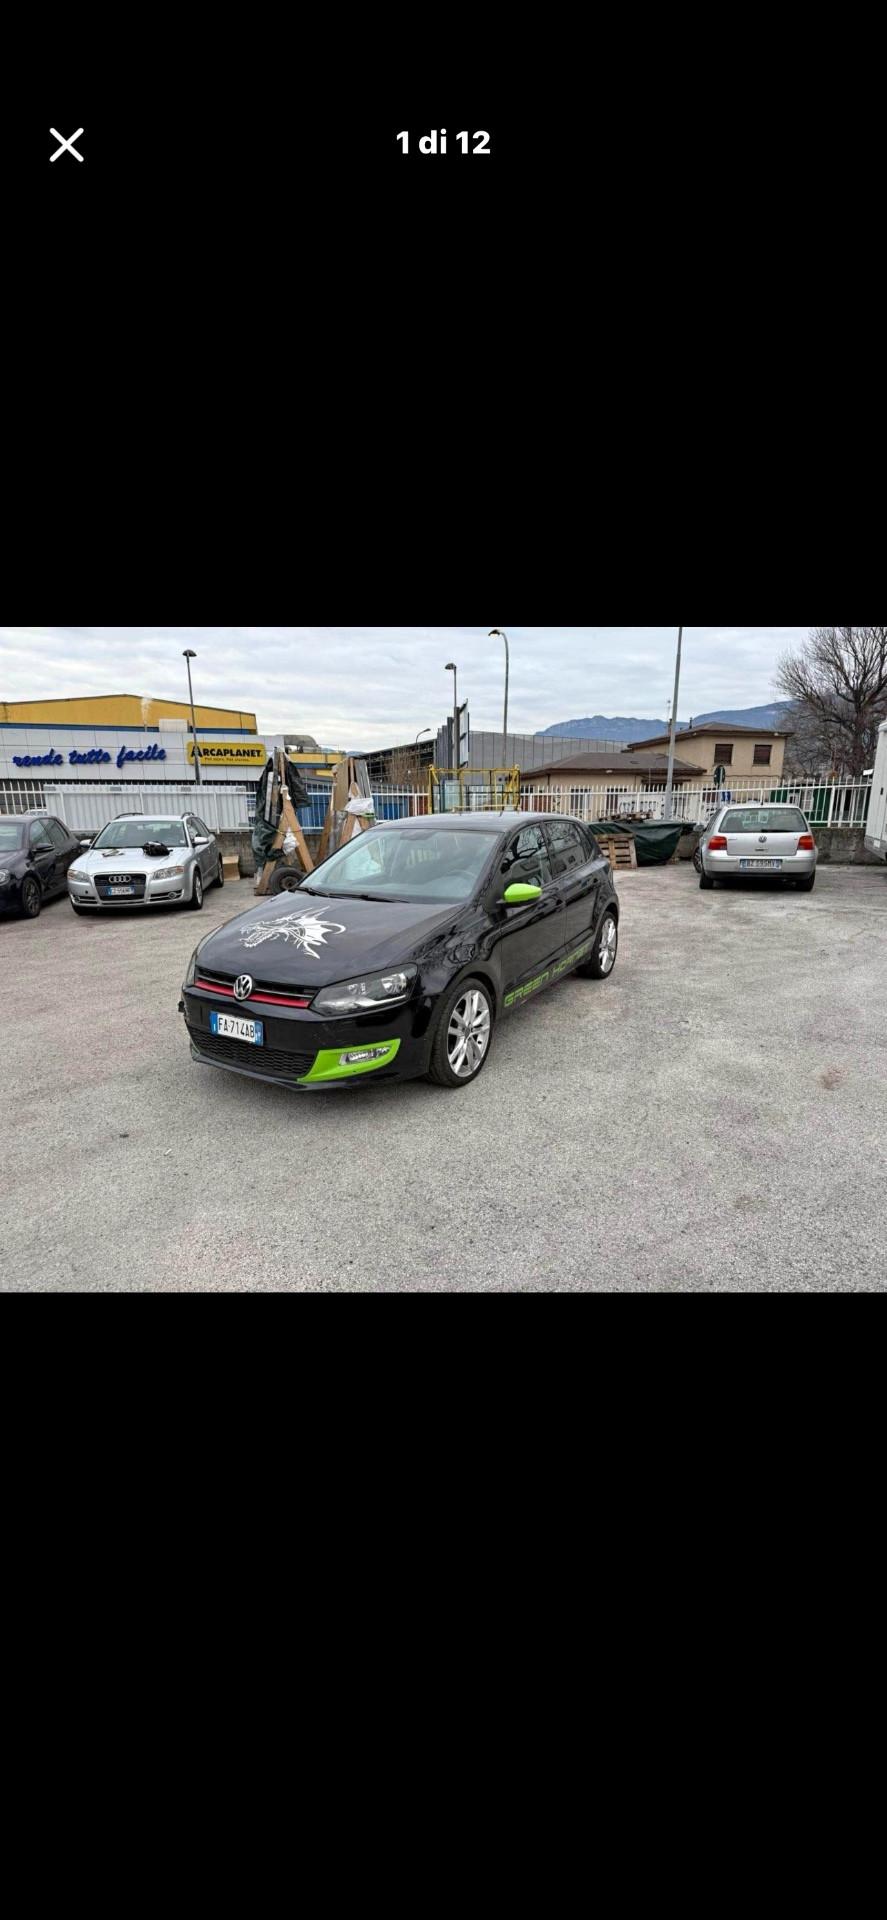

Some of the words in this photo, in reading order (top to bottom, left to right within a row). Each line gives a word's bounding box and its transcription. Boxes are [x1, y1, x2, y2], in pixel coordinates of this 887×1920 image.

[12, 748, 63, 767] rende
[68, 748, 112, 766] tutto
[116, 743, 167, 769] facile
[190, 745, 262, 758] ARCAPLANET
